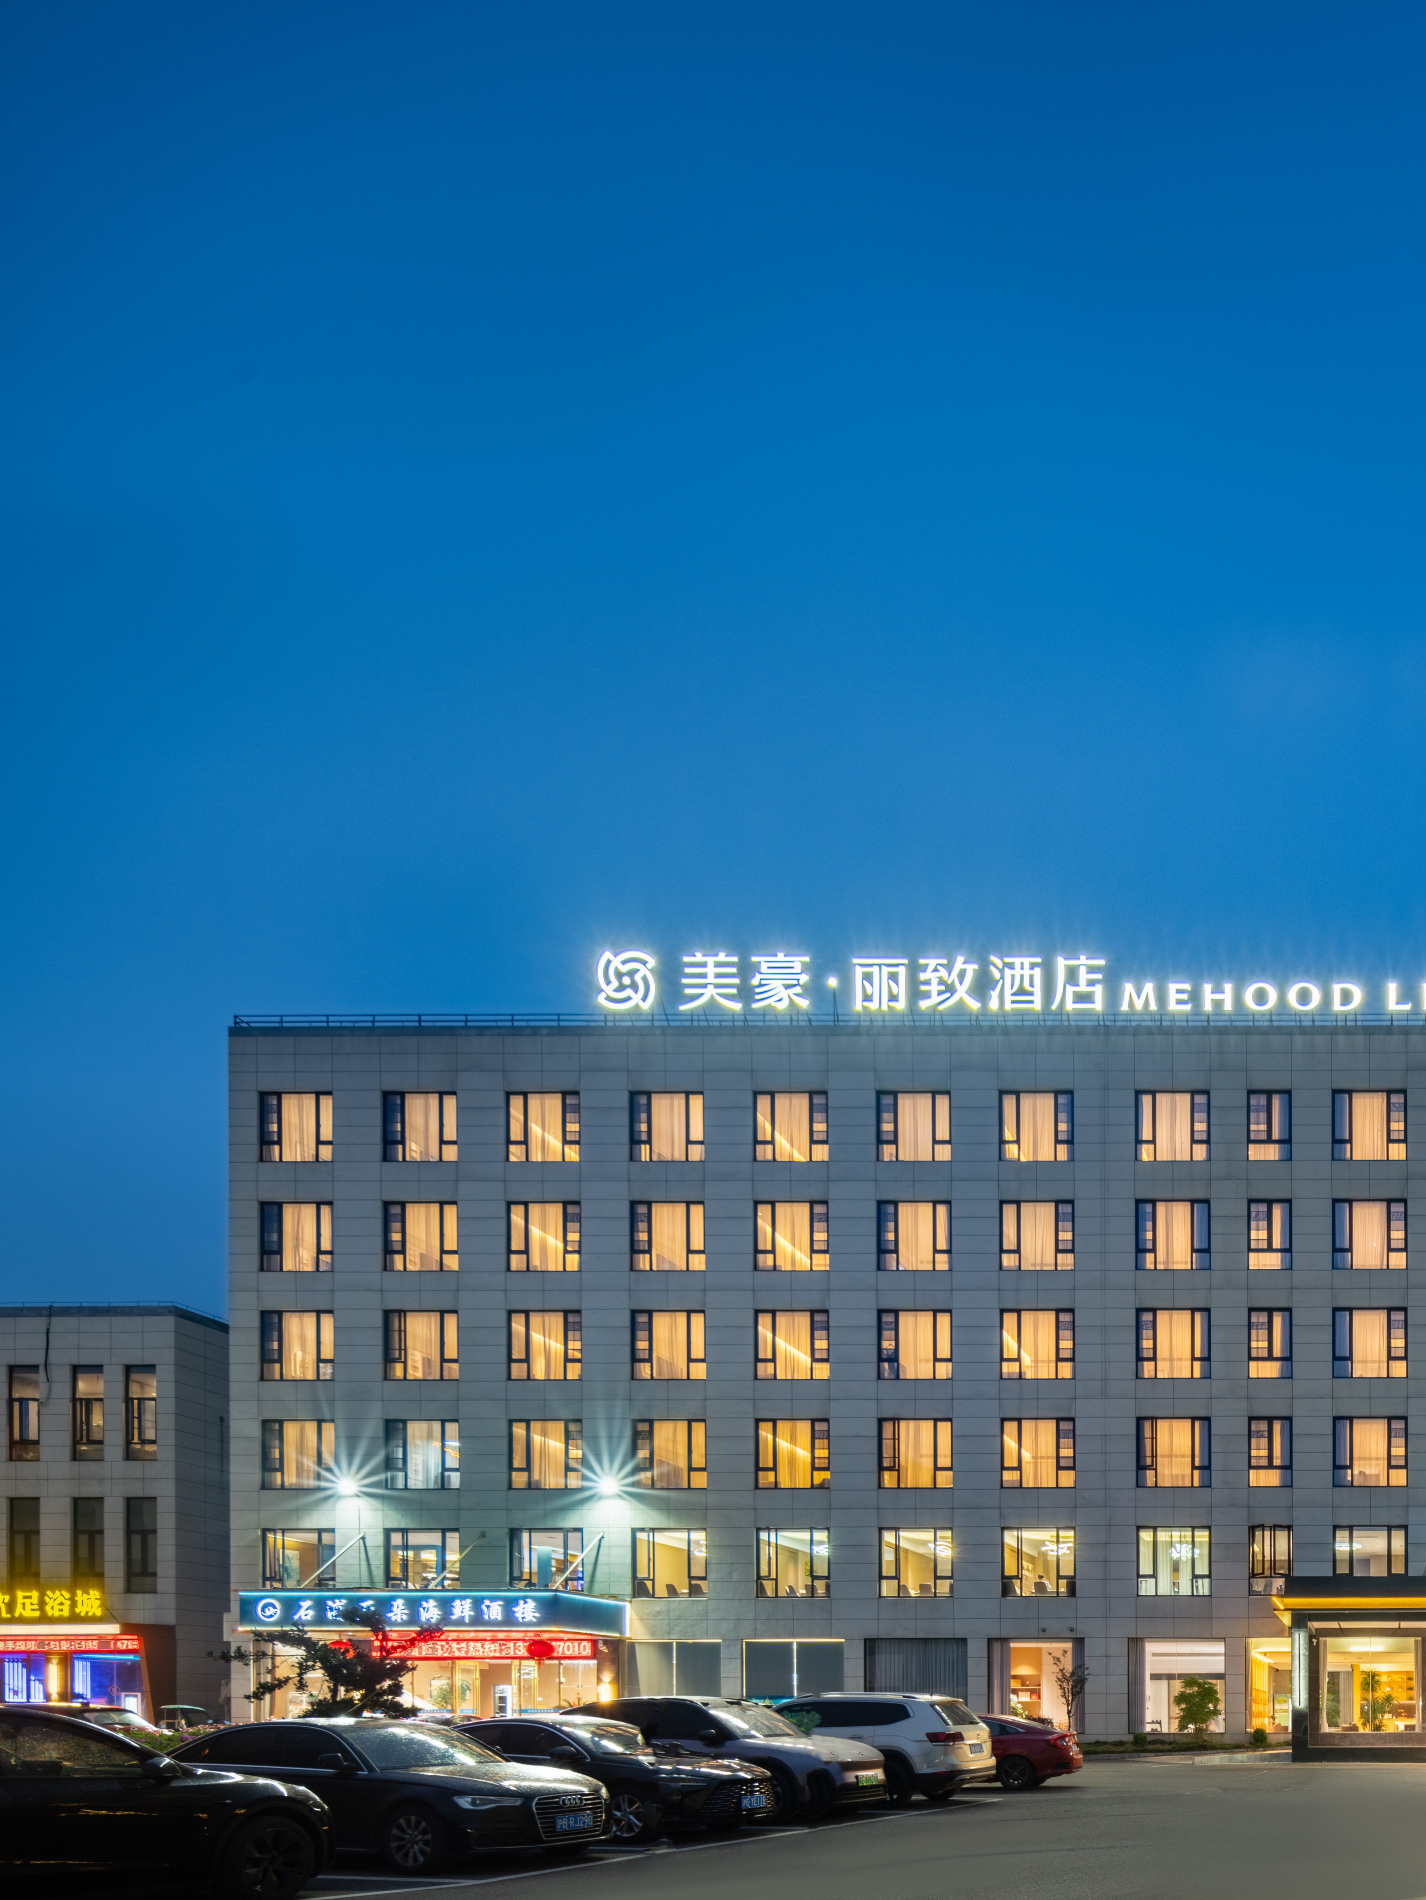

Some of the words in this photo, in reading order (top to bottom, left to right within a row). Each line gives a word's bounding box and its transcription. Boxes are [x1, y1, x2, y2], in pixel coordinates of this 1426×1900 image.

[678, 951, 1107, 1012] 美豪·丽致酒店
[1120, 980, 1363, 1012] MEHOOD
